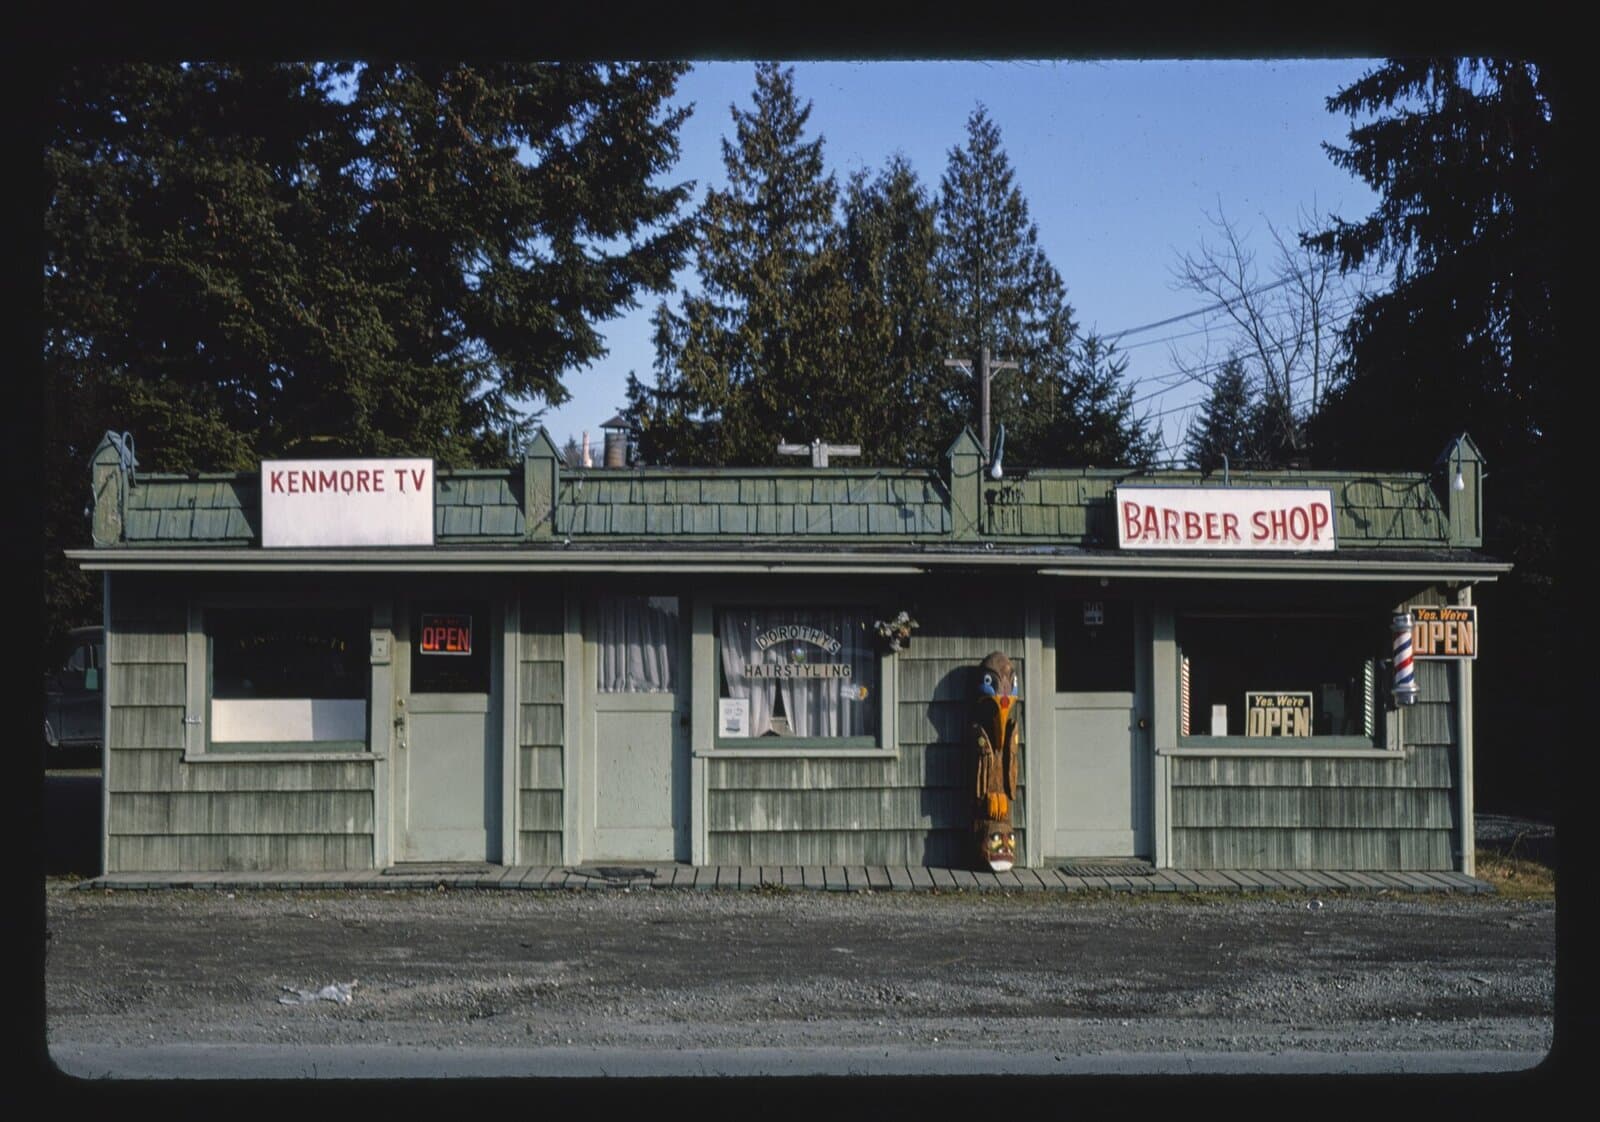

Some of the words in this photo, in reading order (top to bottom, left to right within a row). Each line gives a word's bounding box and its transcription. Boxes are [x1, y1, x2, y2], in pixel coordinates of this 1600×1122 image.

[270, 470, 384, 493] KENMORE
[395, 469, 425, 492] TV
[1122, 500, 1241, 543] BARBER
[1252, 502, 1329, 542] SHOP
[422, 626, 469, 651] OPEN
[1411, 621, 1474, 655] OPEN
[744, 664, 850, 677] HAIRSTYLING
[1249, 707, 1309, 737] OPEN
